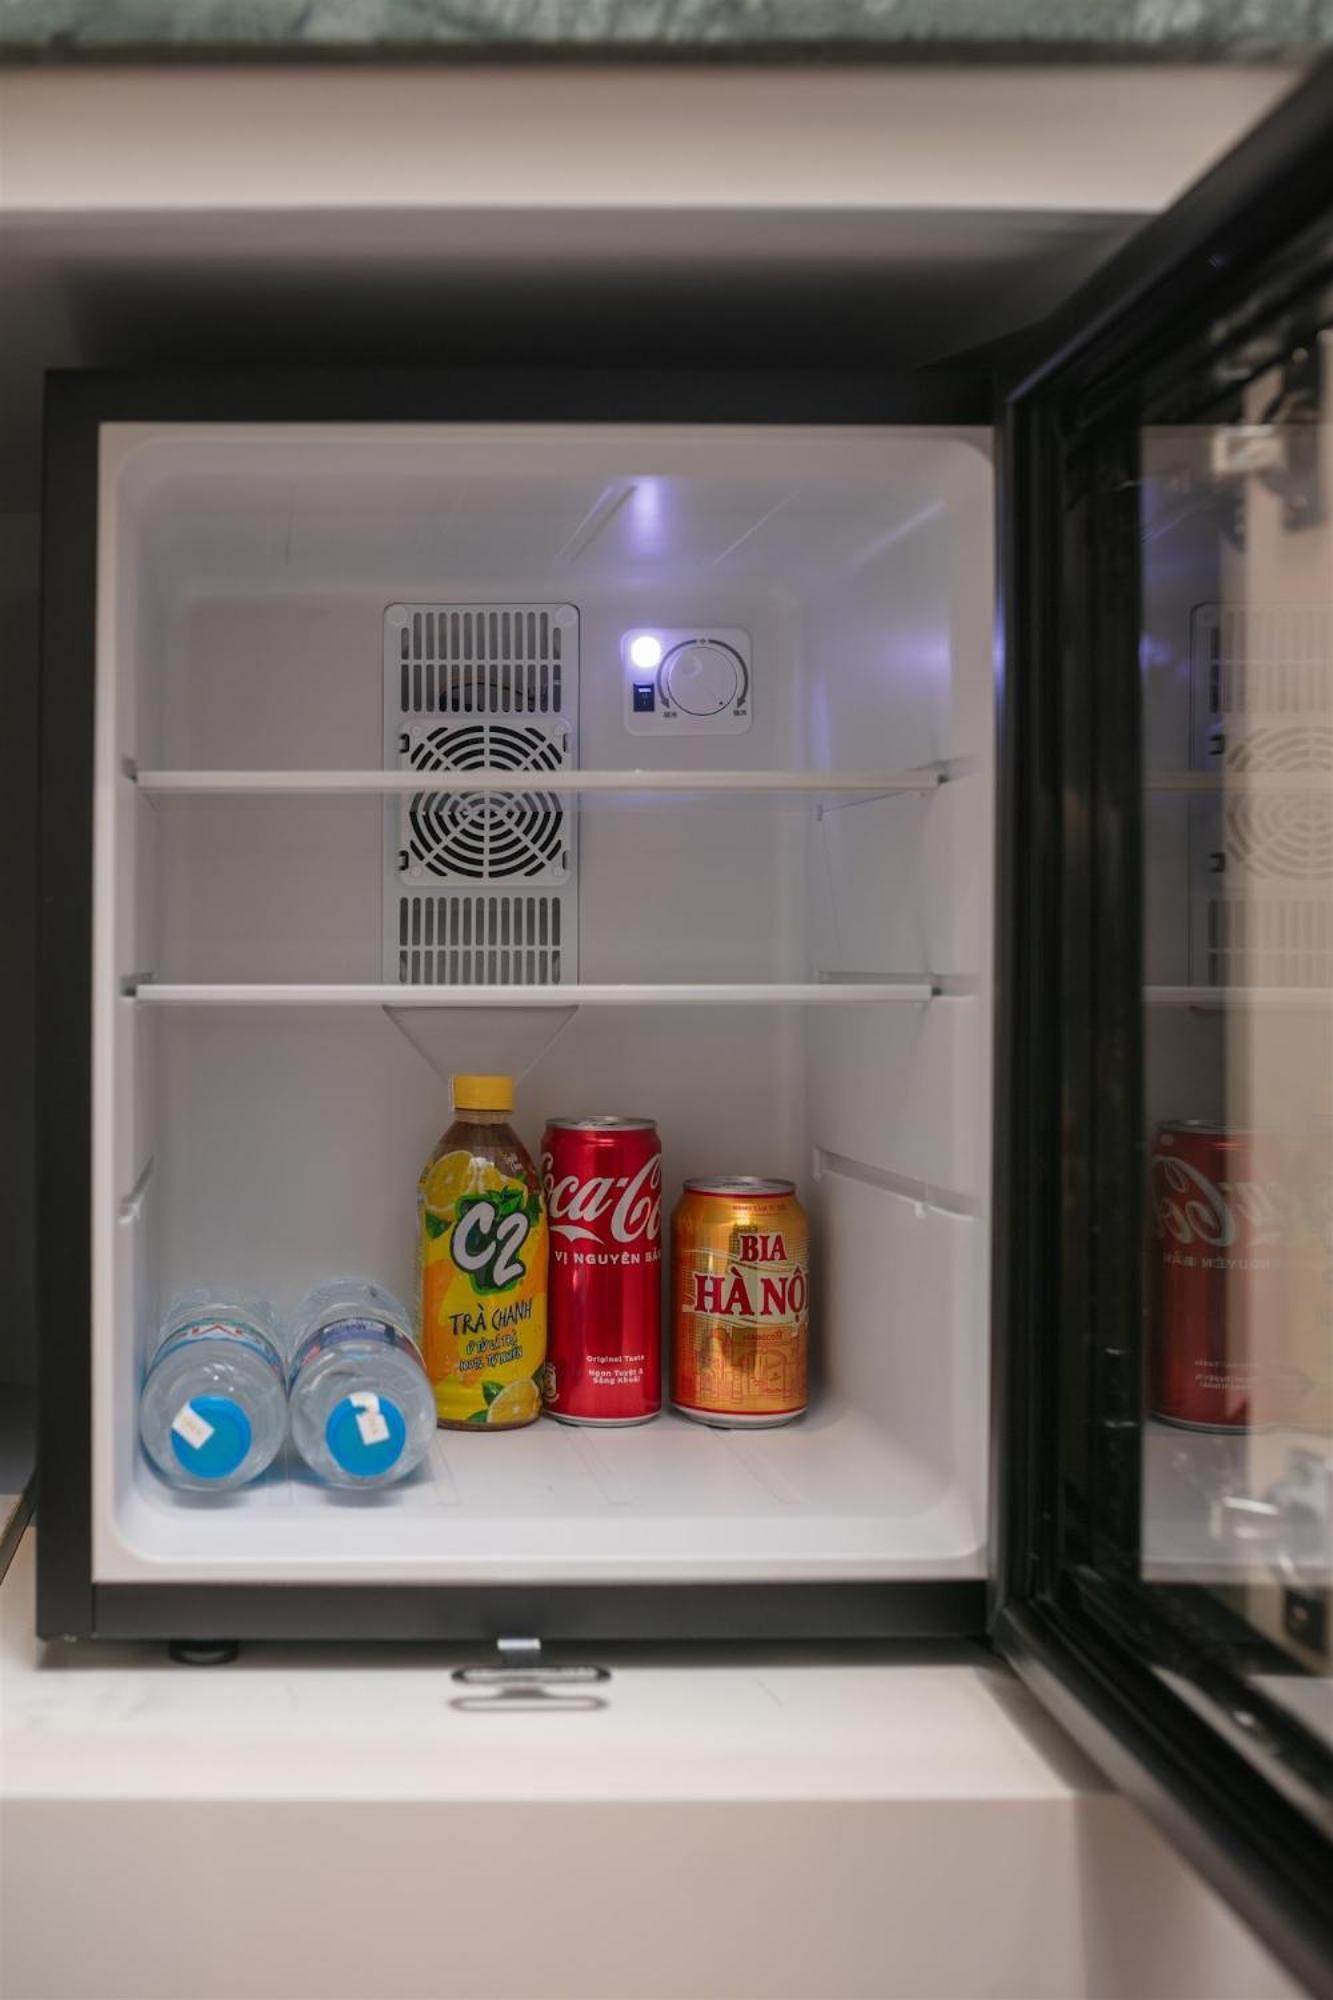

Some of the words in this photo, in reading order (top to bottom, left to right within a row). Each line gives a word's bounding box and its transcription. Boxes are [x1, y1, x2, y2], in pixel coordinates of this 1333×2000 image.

[452, 1201, 529, 1287] C2
[555, 1251, 568, 1265] VỊ
[573, 1251, 641, 1265] NGUYÊN
[739, 1234, 788, 1262] BIA
[694, 1266, 755, 1315] HÀ
[448, 1303, 487, 1335] TRÀ
[492, 1298, 533, 1330] CHANH
[586, 1355, 622, 1364] Original
